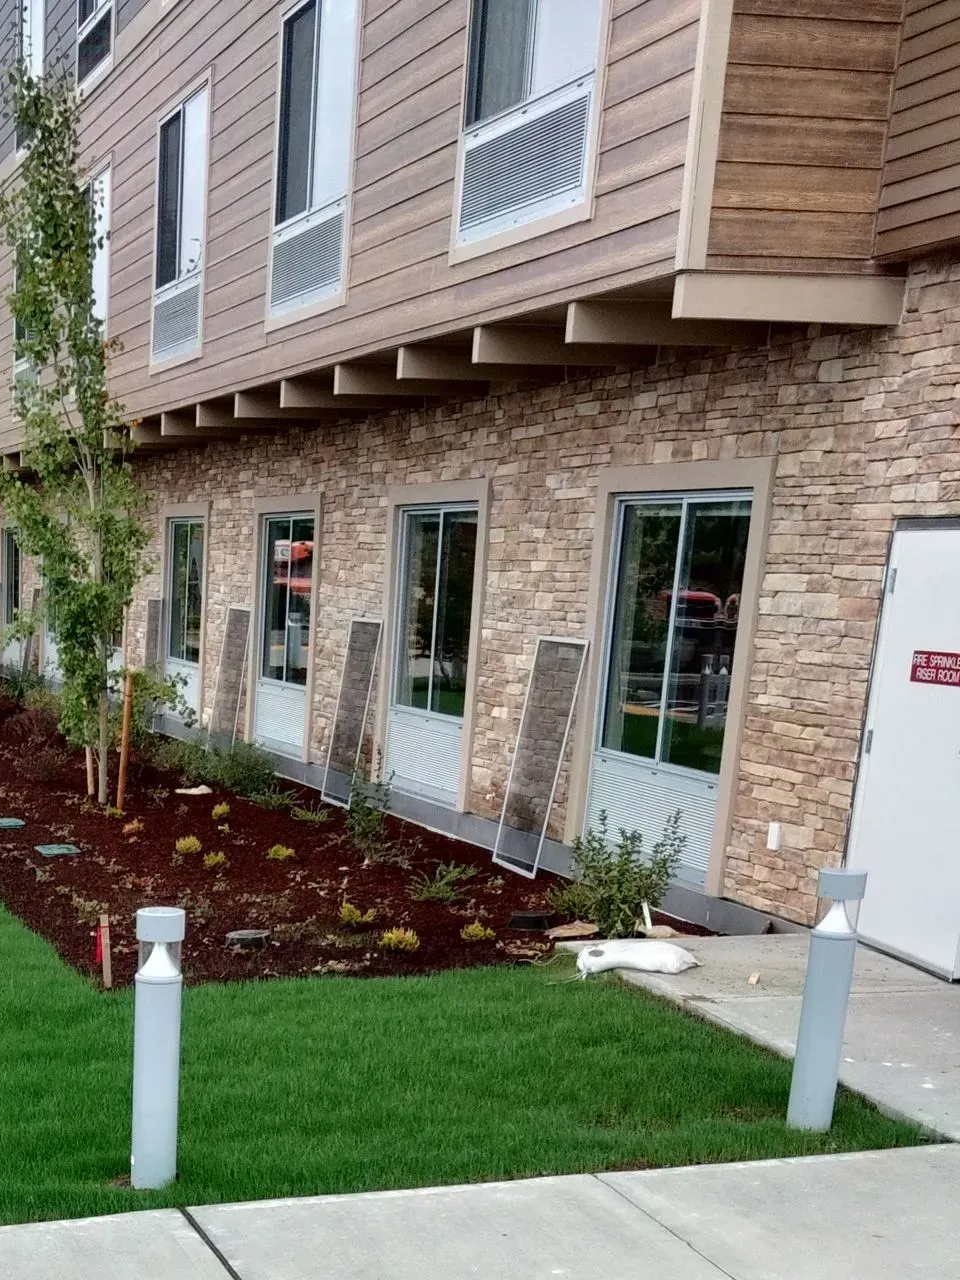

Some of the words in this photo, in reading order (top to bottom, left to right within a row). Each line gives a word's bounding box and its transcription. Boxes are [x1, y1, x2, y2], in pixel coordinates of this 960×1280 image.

[913, 654, 928, 666] FIRE
[916, 668, 936, 680] RISER
[937, 670, 960, 683] ROOM
